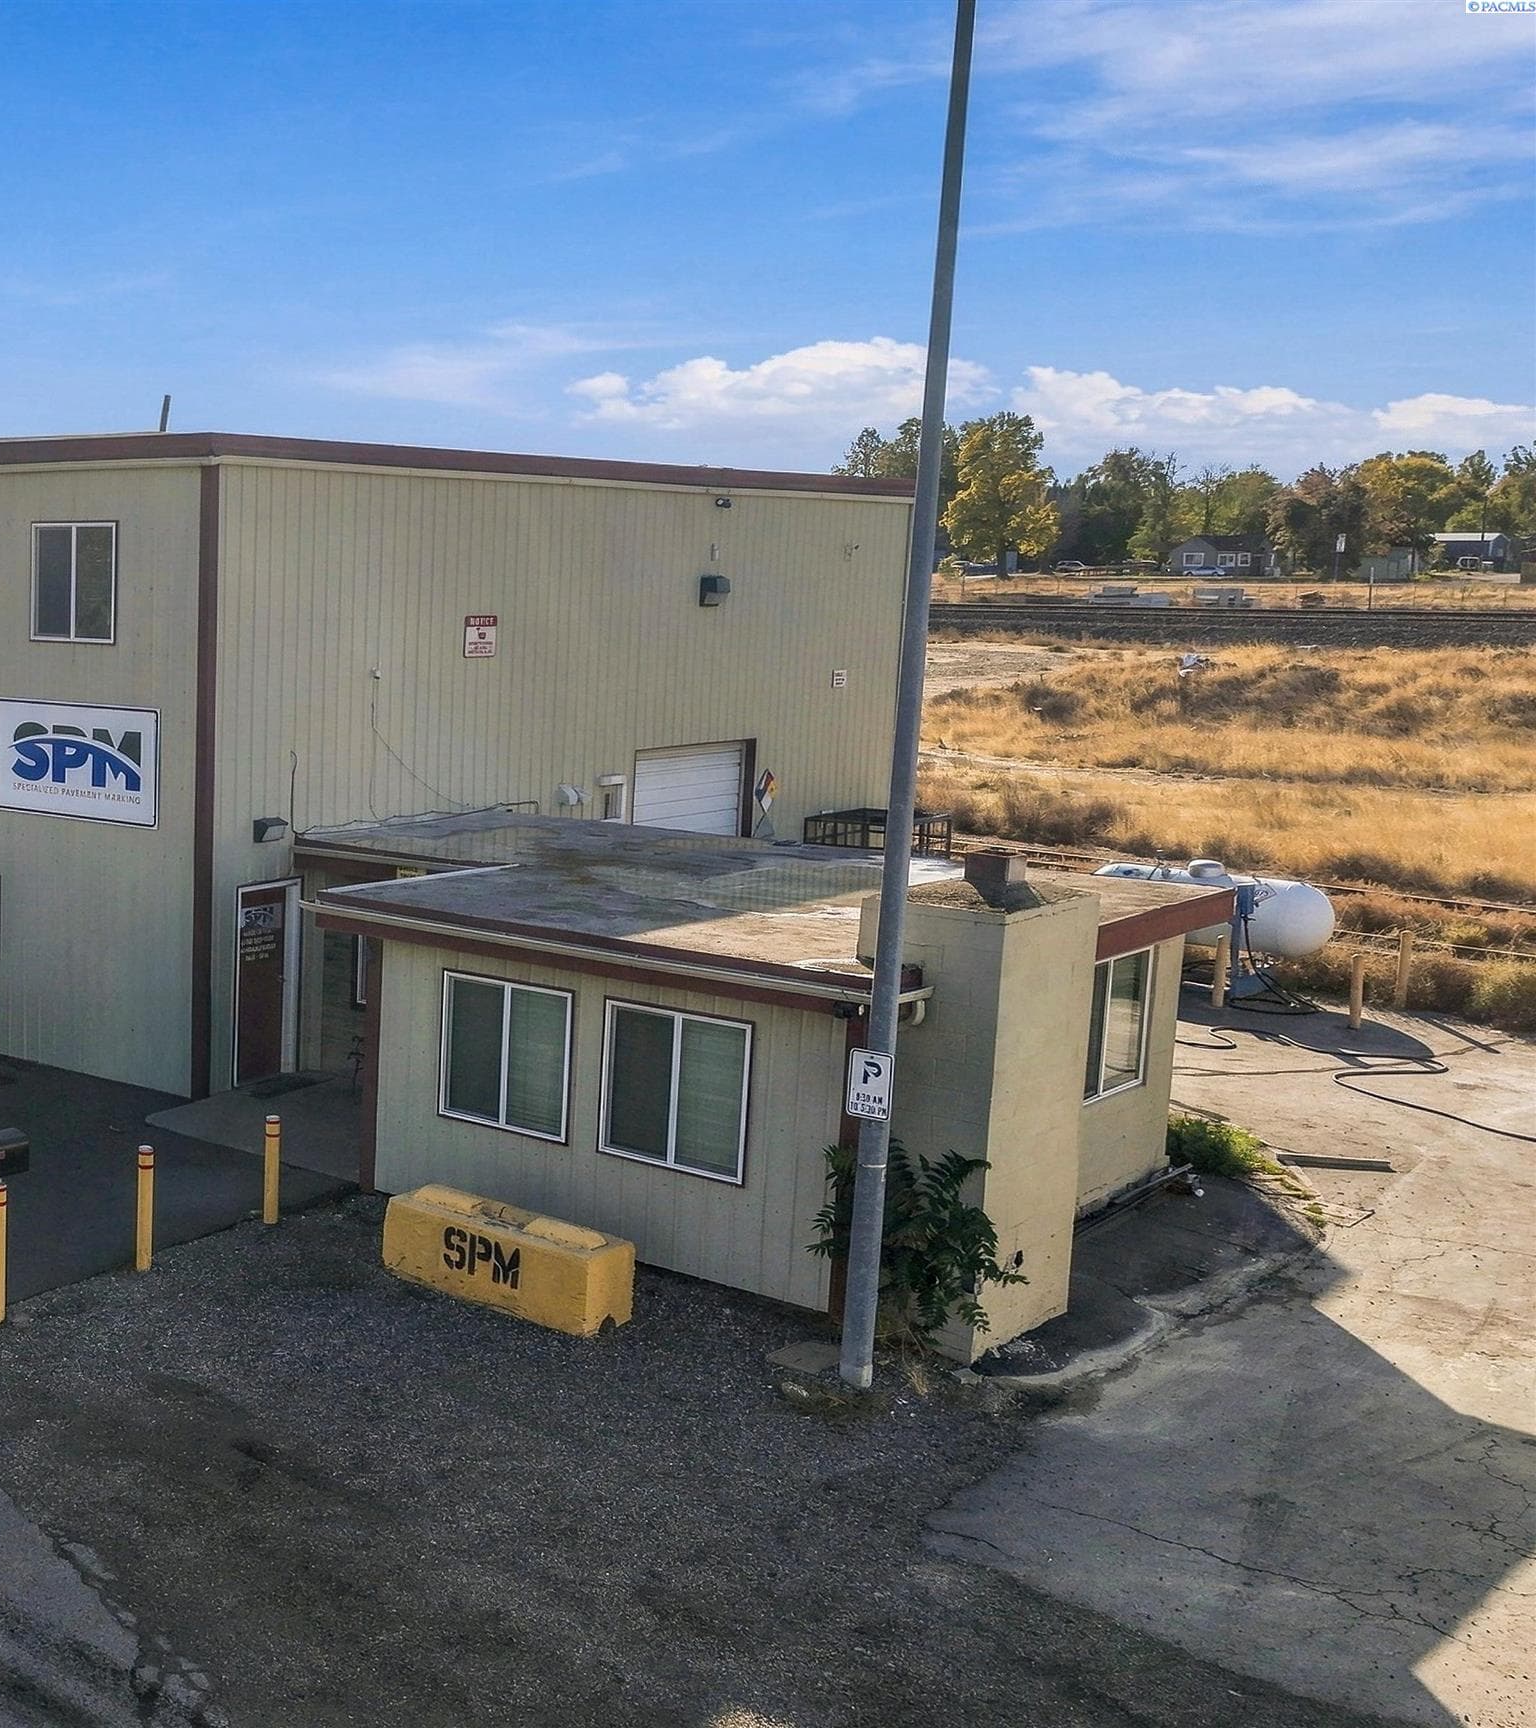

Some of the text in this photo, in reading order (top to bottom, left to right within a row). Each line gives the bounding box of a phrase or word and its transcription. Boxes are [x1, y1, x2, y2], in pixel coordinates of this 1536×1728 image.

[470, 617, 494, 626] NOTICE
[8, 721, 142, 793] SPM
[12, 782, 142, 805] SPECIALIZED PAVEMENT MARKING
[850, 1101, 859, 1111] TO
[877, 1106, 887, 1116] PM
[873, 1095, 883, 1105] AM
[443, 1225, 521, 1290] SPM
